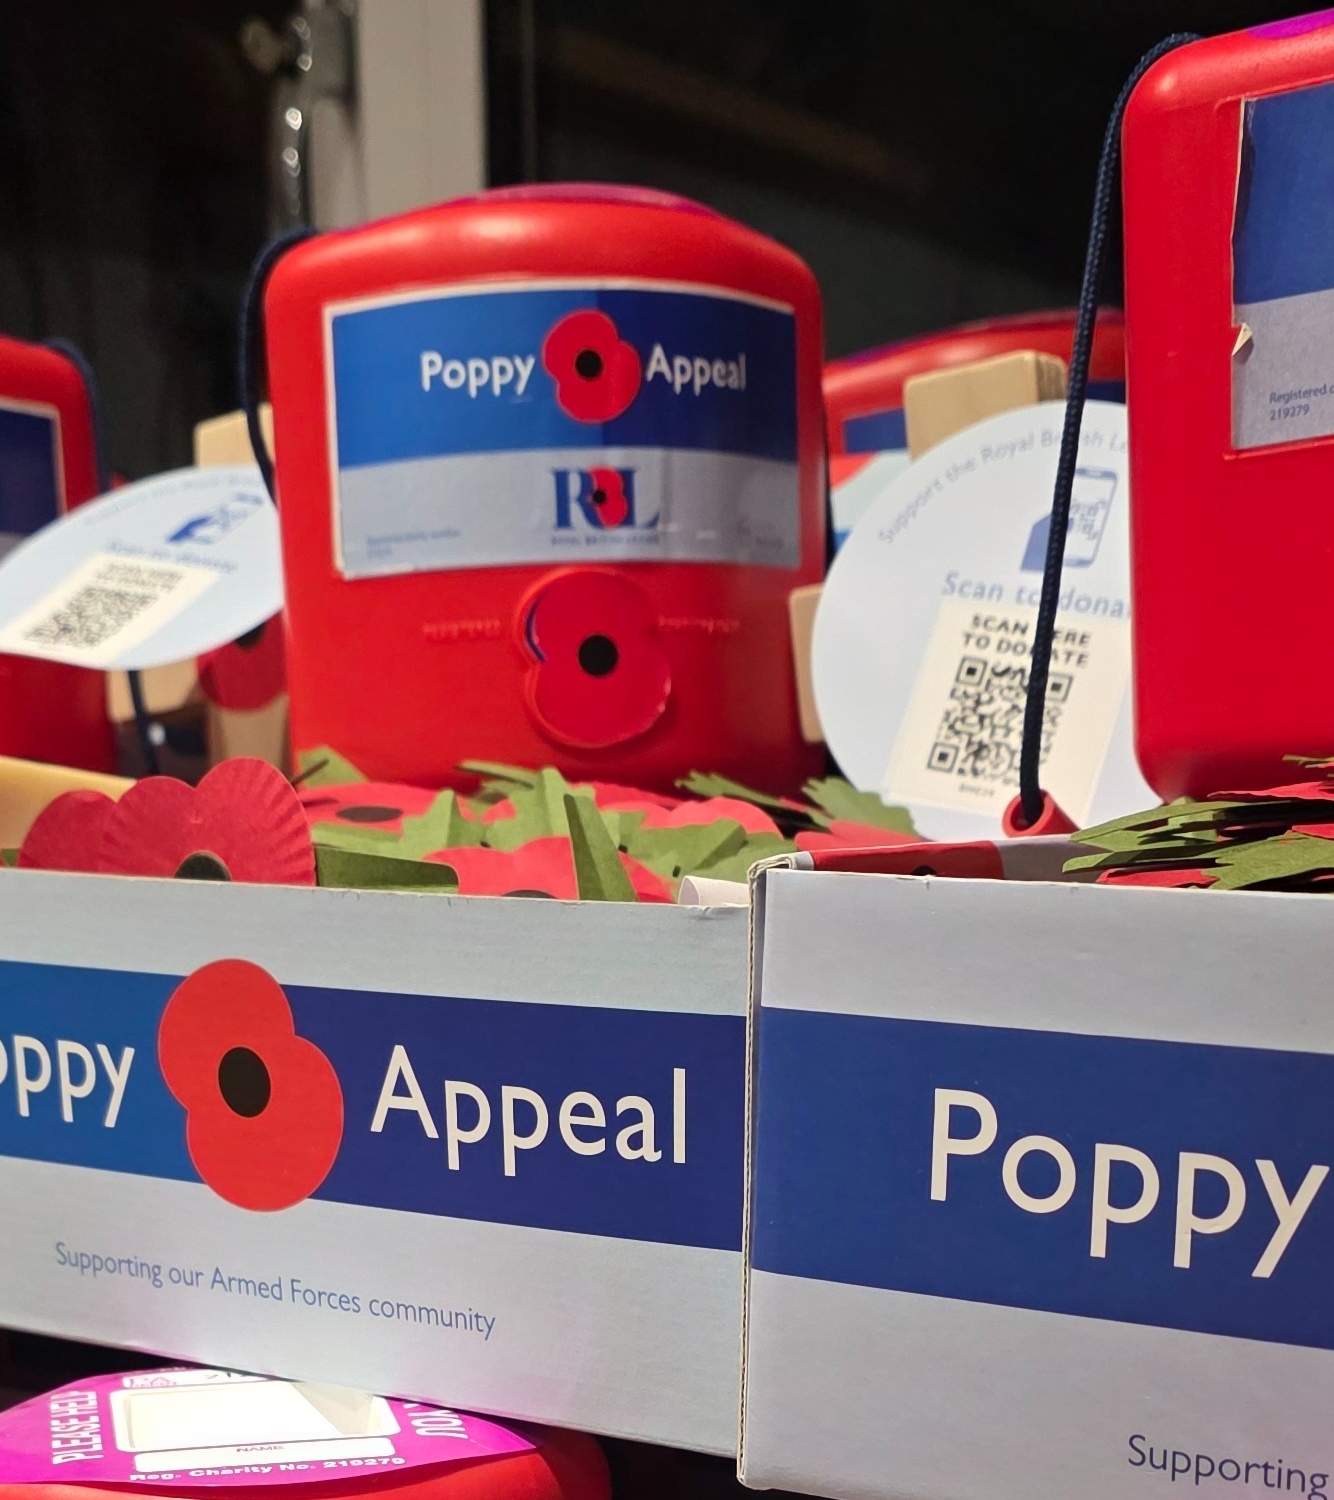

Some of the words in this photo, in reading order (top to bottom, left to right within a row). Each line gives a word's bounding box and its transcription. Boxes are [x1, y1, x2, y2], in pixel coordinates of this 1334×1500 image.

[420, 350, 535, 398] Poppy
[645, 345, 747, 394] Appeal
[1269, 383, 1327, 404] Registered
[1269, 403, 1311, 421] 219279
[940, 571, 1005, 602] Scan
[1058, 586, 1130, 618] dona
[962, 632, 991, 650] TO
[996, 638, 1090, 668] DOATE
[971, 613, 1030, 636] SCAN
[1052, 628, 1092, 646] ERE
[370, 1043, 688, 1179] Appeal
[929, 1086, 1332, 1283] Poppy
[55, 1240, 164, 1290] Supporting
[168, 1263, 205, 1289] our
[210, 1267, 284, 1302] Armed
[290, 1279, 362, 1315] Forces
[368, 1296, 497, 1342] community
[188, 1463, 273, 1479] Charity
